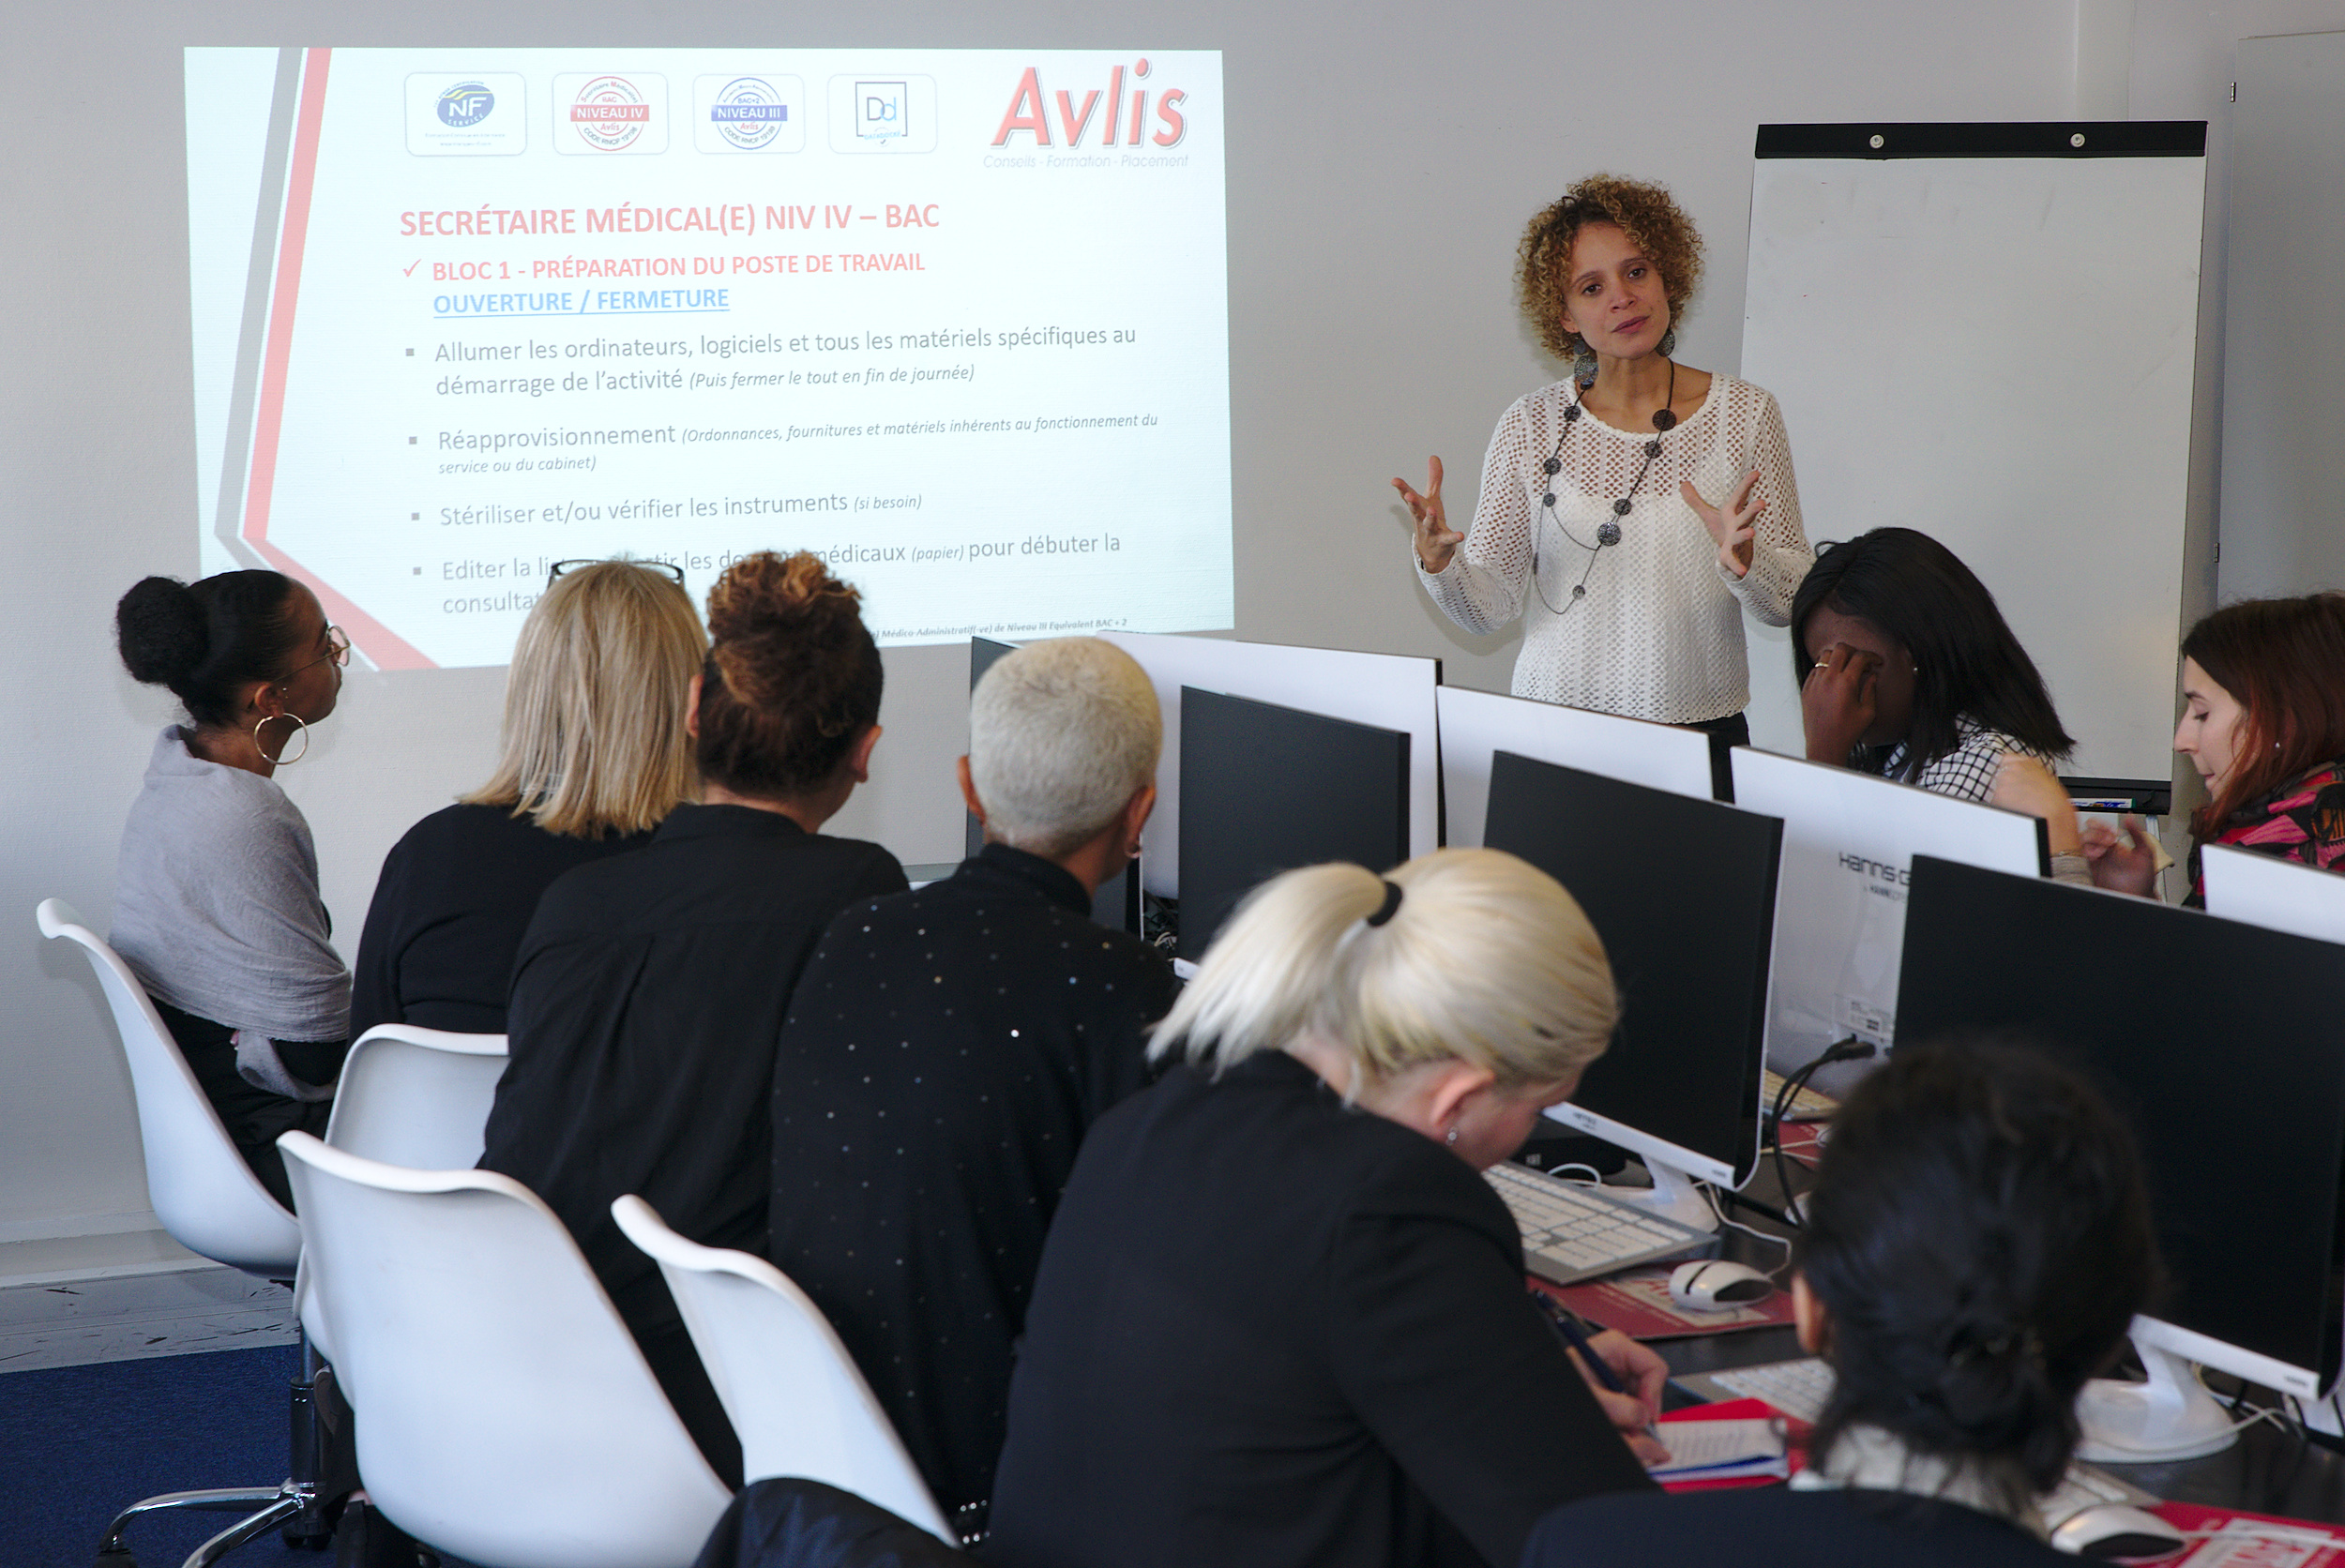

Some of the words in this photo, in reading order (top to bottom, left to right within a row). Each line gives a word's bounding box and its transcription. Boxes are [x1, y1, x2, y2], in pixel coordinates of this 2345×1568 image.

[449, 97, 487, 116] NF
[576, 107, 628, 119] NIVEAU
[630, 107, 644, 119] IV
[717, 107, 766, 119] NIVEAU
[768, 107, 780, 119] III
[991, 58, 1188, 149] Avlis
[983, 156, 1036, 168] Conseils
[1047, 155, 1111, 168] Formation
[1121, 155, 1188, 167] Placement
[401, 204, 576, 235] SECRÉTAIRE
[586, 202, 755, 236] MÉDICAL(E)
[766, 205, 815, 230] NIV
[825, 205, 852, 229] IV
[886, 204, 939, 228] BAC
[433, 262, 492, 280] BLOC
[499, 262, 510, 279] 1
[533, 255, 686, 279] PRÉPARATION
[694, 257, 724, 275] DU
[733, 255, 798, 274] POSTE
[807, 255, 832, 273] DE
[839, 253, 925, 272] TRAVAIL
[433, 293, 573, 314] OUVERTURE
[598, 289, 730, 310] FERMETURE
[435, 341, 522, 362] Allumer
[529, 339, 558, 359] les
[565, 338, 692, 358] ordinateurs,
[701, 333, 782, 359] logiciels
[789, 335, 809, 352] et
[815, 331, 859, 352] tous
[867, 331, 893, 350] les
[900, 327, 991, 349] matériels
[998, 326, 1107, 350] spécifiques
[1113, 326, 1135, 343] au
[436, 375, 555, 398] démarrage
[563, 371, 588, 391] de
[597, 369, 683, 390] l’activité
[689, 372, 727, 390] (Puis
[730, 371, 785, 390] fermer
[789, 370, 802, 384] le
[807, 368, 839, 384] tout
[842, 368, 860, 384] en
[863, 368, 885, 385] fin
[889, 368, 908, 382] de
[910, 364, 975, 384] journée)
[439, 426, 675, 453] Réapprovisionnement
[682, 429, 782, 445] (Ordonnances,
[785, 424, 862, 442] fournitures
[867, 424, 880, 435] et
[884, 420, 946, 435] matériels
[950, 419, 1011, 432] inhérents
[1015, 416, 1032, 430] au
[1034, 415, 1138, 433] fonctionnement
[1142, 414, 1157, 426] du
[439, 460, 489, 475] service
[492, 458, 511, 473] ou
[516, 458, 534, 471] du
[537, 455, 597, 472] cabinet)
[441, 505, 536, 526] Stériliser
[542, 501, 600, 524] et/ou
[608, 499, 683, 519] vérifier
[690, 497, 718, 517] les
[725, 494, 848, 515] instruments
[854, 496, 870, 513] (si
[873, 494, 922, 510] besoin)
[444, 560, 507, 580] Editer
[514, 557, 531, 577] la
[686, 552, 711, 569] les
[912, 545, 964, 563] (papier)
[969, 536, 1015, 562] pour
[1021, 535, 1098, 555] débuter
[1105, 533, 1120, 551] la
[993, 623, 1006, 632] de
[1006, 622, 1037, 633] Niveau
[1049, 619, 1095, 632] Equivalent
[1096, 618, 1113, 627] BAC
